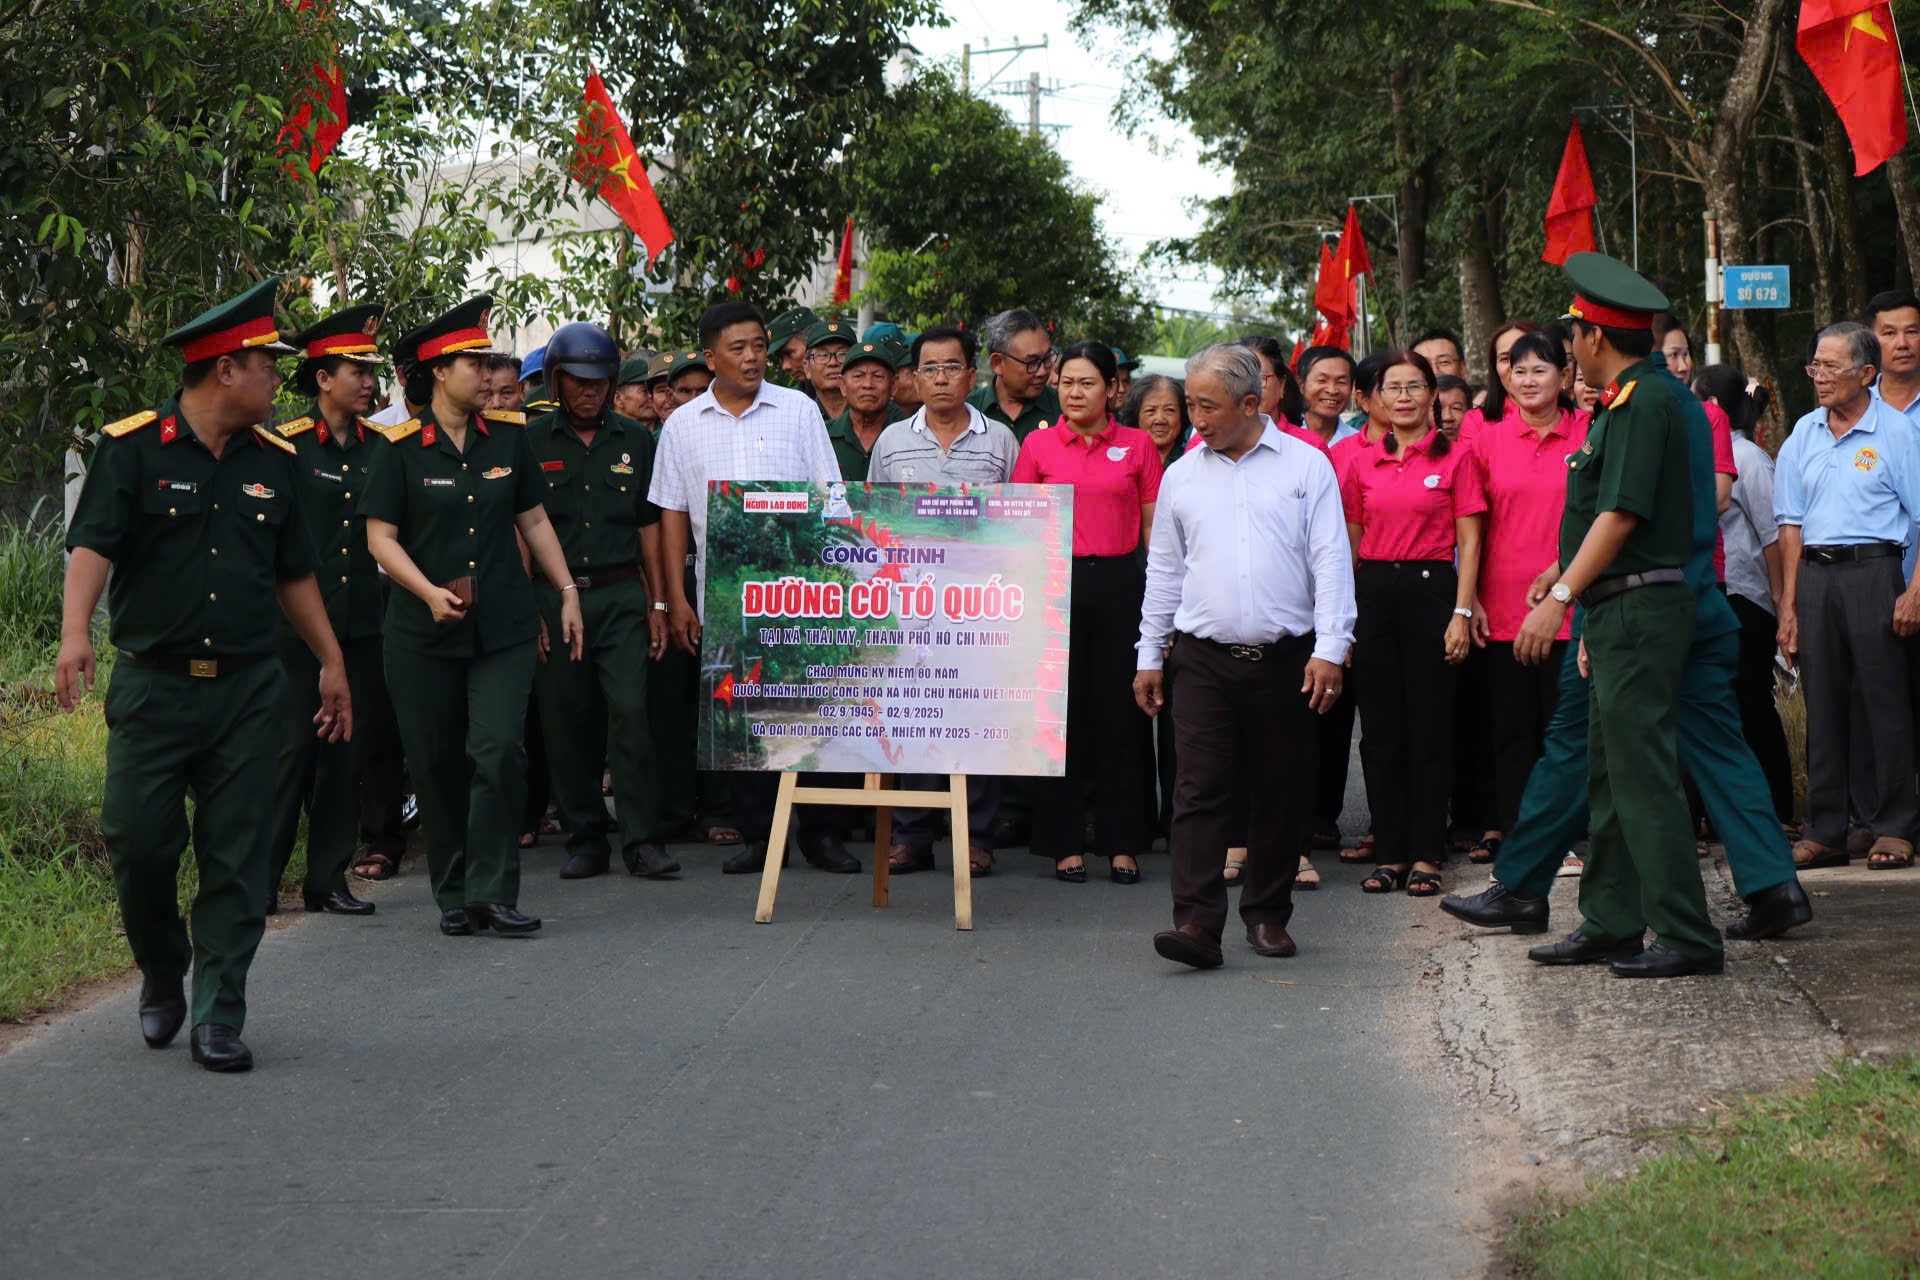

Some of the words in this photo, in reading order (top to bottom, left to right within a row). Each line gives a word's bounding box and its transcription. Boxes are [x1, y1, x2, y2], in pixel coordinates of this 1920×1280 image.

[1755, 287, 1777, 301] 679
[770, 501, 785, 510] LAO
[822, 544, 879, 564] CÔNG
[884, 545, 945, 564] TRÌNH
[743, 578, 842, 617] ĐƯỜNG
[849, 578, 892, 617] CỜ
[897, 574, 936, 619] TỔ
[943, 575, 1024, 623] QUỐC
[760, 628, 780, 647] TẠI
[784, 626, 800, 645] XÃ
[805, 626, 834, 645] THÁI
[836, 626, 861, 647] MỸ,
[865, 627, 905, 646] THÀNH
[908, 628, 932, 646] PHỐ
[936, 627, 952, 646] HỒ
[956, 628, 975, 646] CHÍ
[979, 631, 1010, 647] MINH
[807, 664, 834, 678] CHÀO
[837, 664, 869, 678] MỪNG
[918, 667, 931, 679] 80
[733, 680, 761, 697] QUỐC
[763, 682, 798, 697] KHÁNH
[801, 683, 829, 698] NƯỚC
[886, 685, 900, 698] XÃ
[924, 684, 945, 699] CHỦ
[948, 685, 980, 700] NGHĨA
[1008, 688, 1032, 700] NAM
[818, 705, 874, 719] (02/9/1945
[887, 706, 944, 719] 02/9/2025)
[753, 722, 766, 736] VÀ
[811, 722, 839, 737] ĐẢNG
[945, 728, 970, 739] 2025
[983, 728, 1009, 740] 2030
